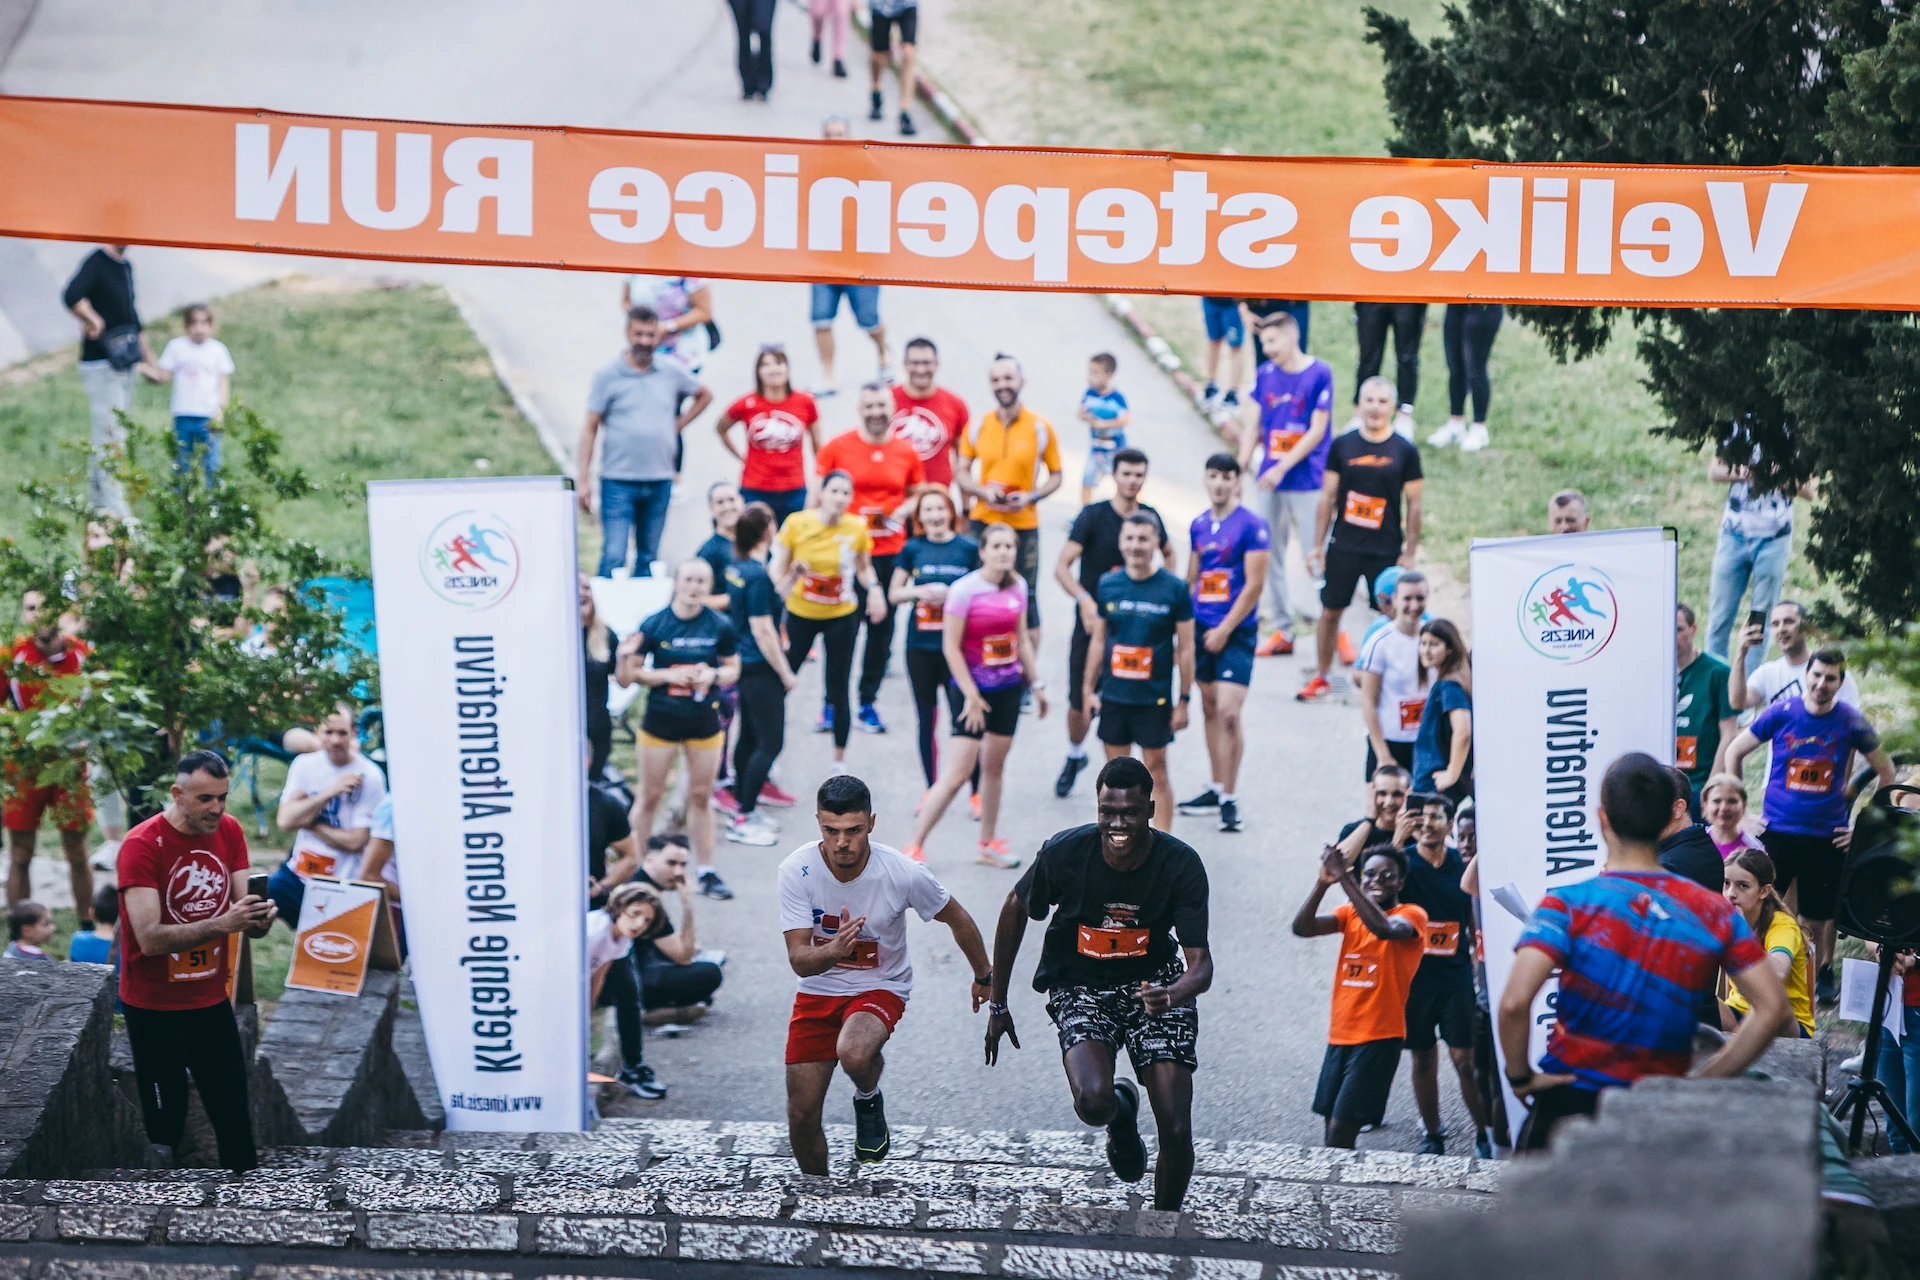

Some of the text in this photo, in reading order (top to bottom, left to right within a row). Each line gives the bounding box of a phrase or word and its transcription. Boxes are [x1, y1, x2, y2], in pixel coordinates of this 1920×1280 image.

[182, 898, 217, 912] KINEZIS
[1109, 938, 1117, 949] 1
[1430, 933, 1448, 945] 67
[189, 950, 207, 967] 51
